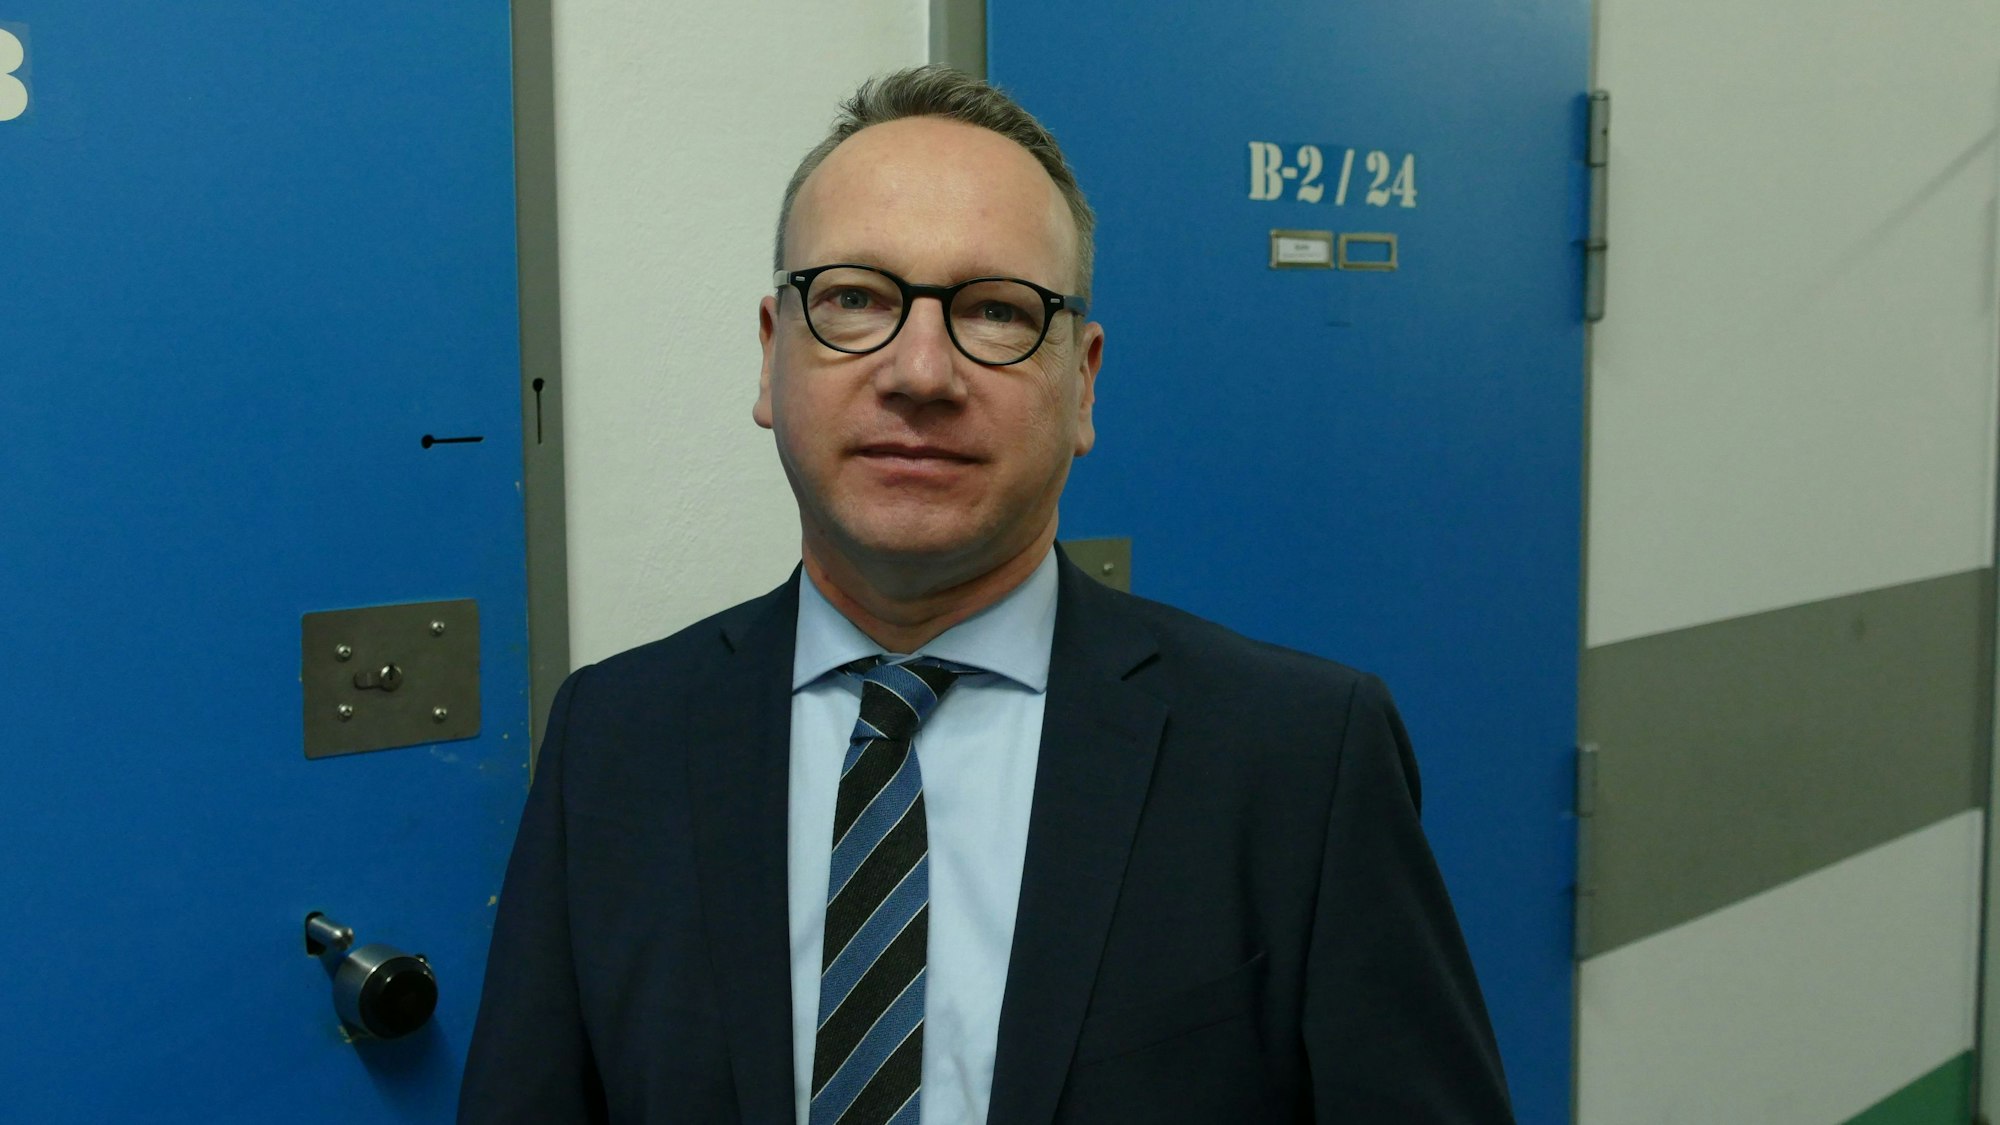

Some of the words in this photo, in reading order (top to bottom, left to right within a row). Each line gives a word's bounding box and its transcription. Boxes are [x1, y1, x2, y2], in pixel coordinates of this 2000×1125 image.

[1248, 141, 1324, 204] B-2
[1335, 149, 1355, 206] /
[1366, 151, 1417, 208] 24
